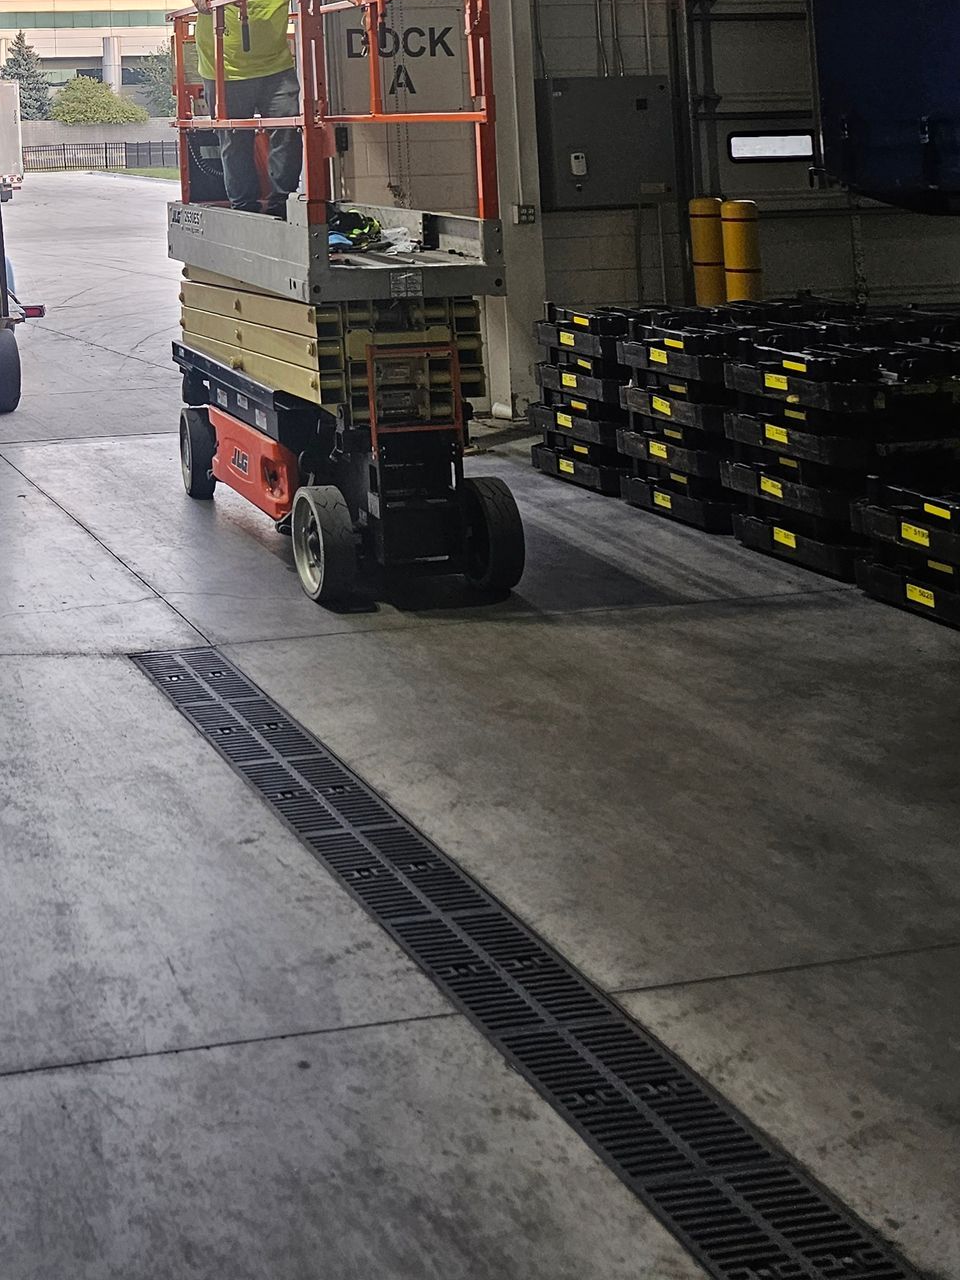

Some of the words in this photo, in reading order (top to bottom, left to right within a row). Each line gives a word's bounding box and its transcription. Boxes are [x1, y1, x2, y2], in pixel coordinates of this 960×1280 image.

[346, 26, 455, 58] DOCK
[388, 64, 417, 95] A
[231, 446, 249, 475] JLG
